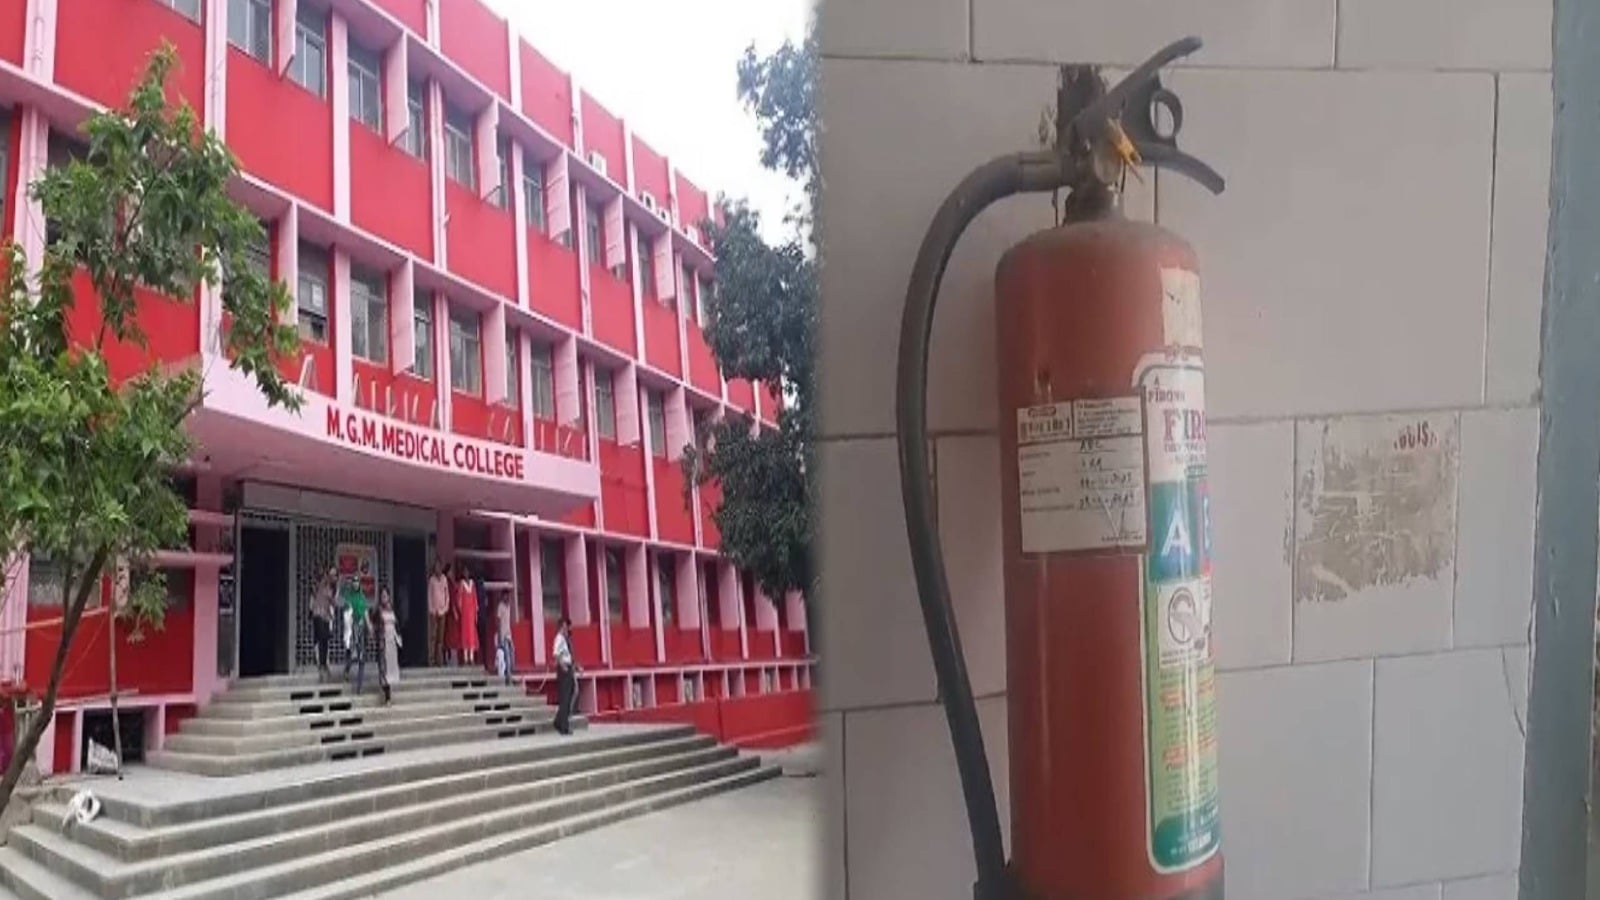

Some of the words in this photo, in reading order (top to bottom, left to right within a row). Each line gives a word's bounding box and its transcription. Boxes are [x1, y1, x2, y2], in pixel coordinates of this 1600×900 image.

[382, 424, 451, 466] MEDICAL
[453, 442, 525, 479] COLLEGE
[1160, 508, 1193, 557] A
